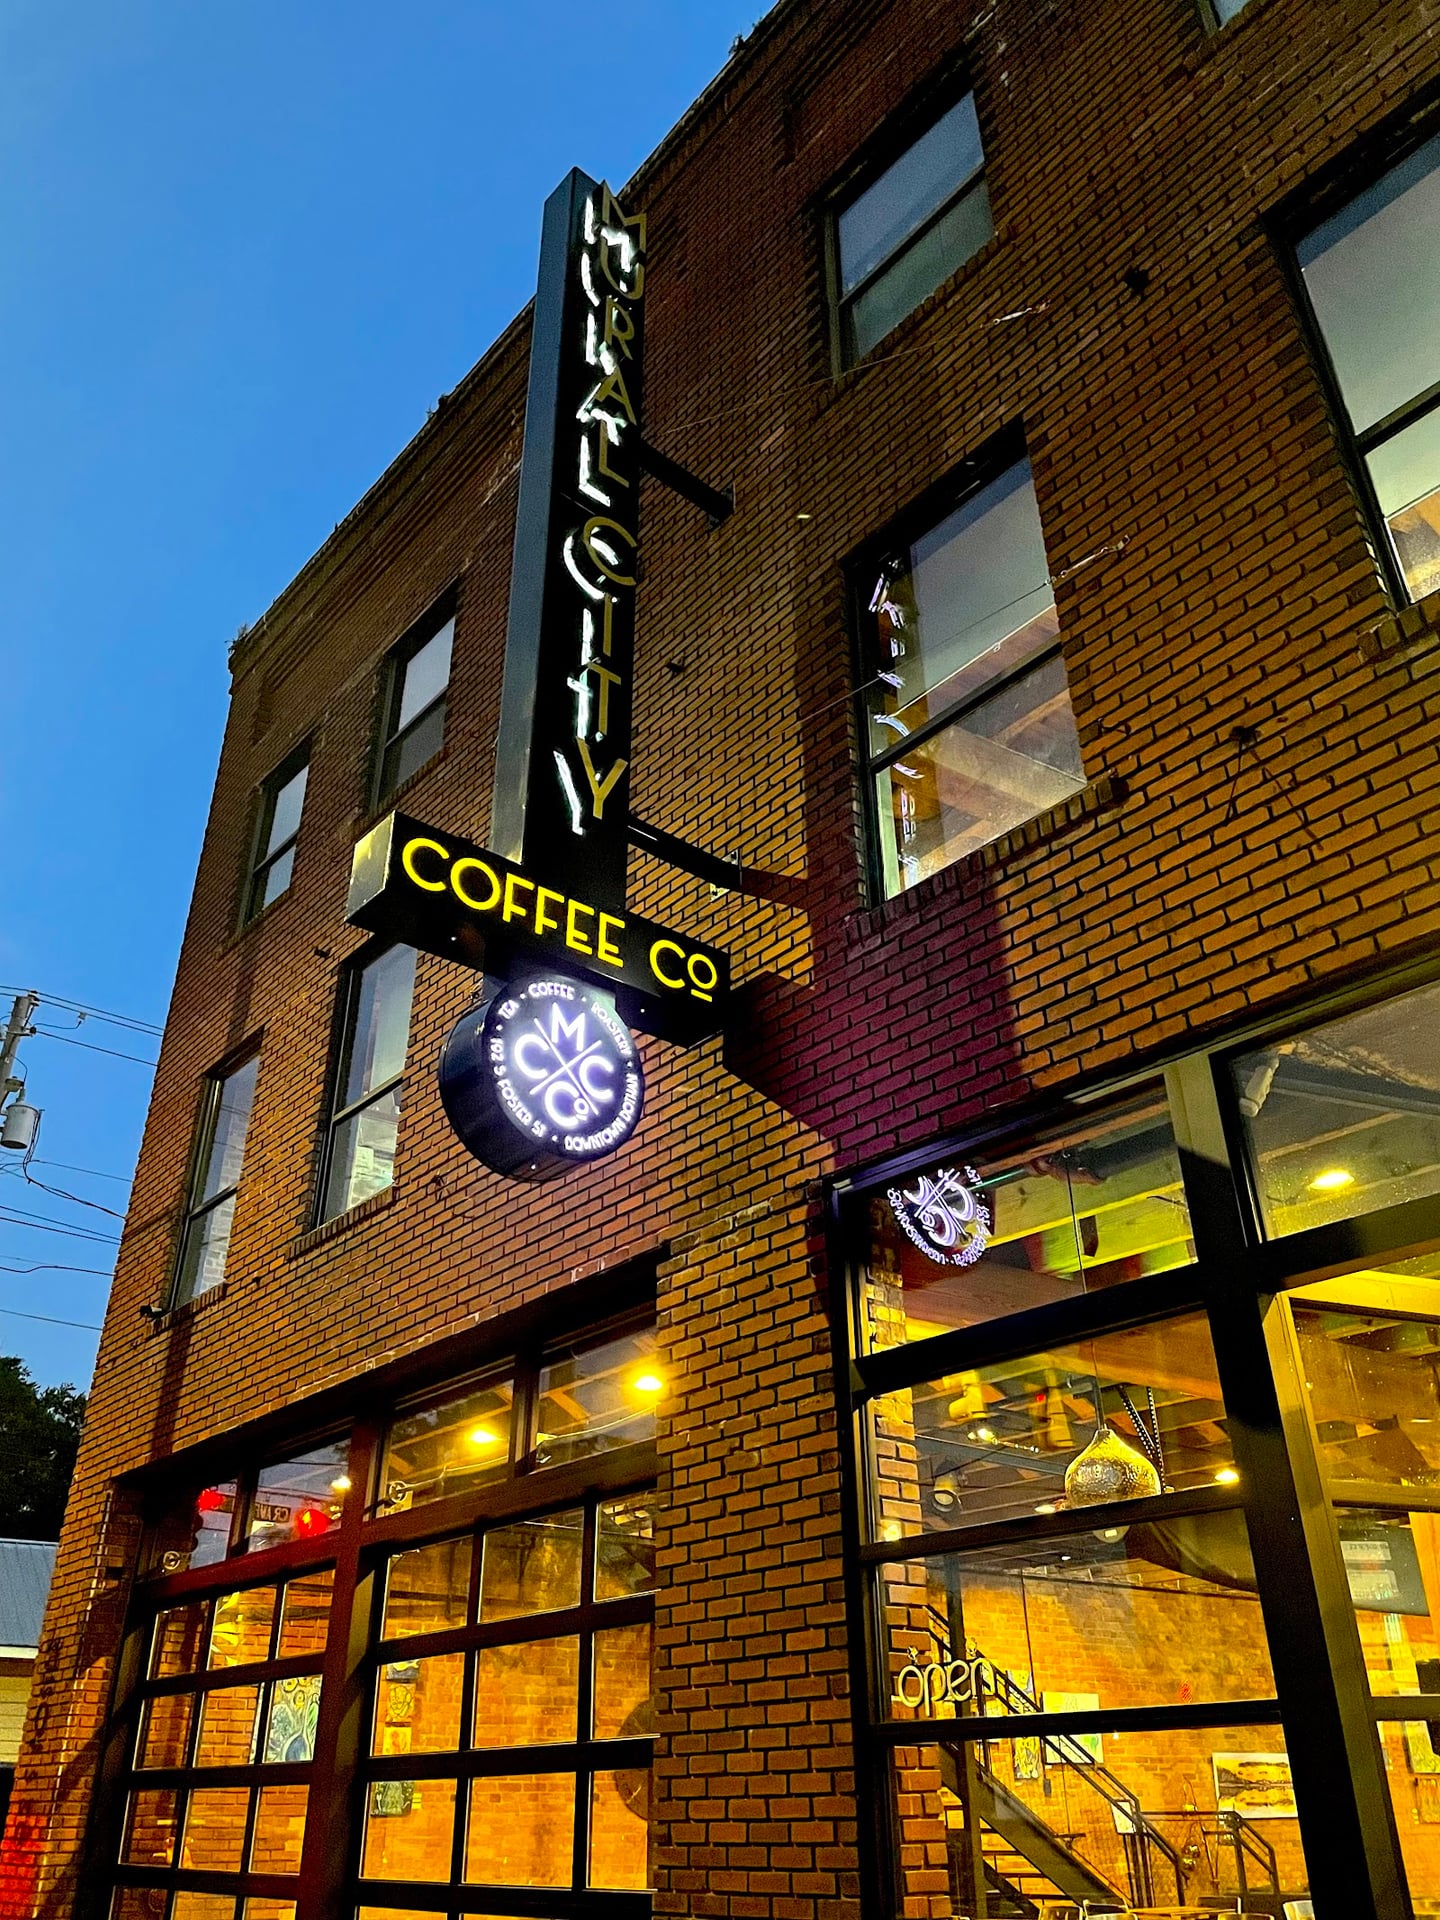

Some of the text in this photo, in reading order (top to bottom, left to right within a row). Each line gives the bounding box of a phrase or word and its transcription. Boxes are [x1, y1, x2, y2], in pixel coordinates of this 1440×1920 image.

[553, 178, 647, 836] MURAL CITY
[402, 837, 626, 968] COFFEE
[498, 982, 632, 1056] TEA COFFEE ROASTERY
[490, 1037, 504, 1061] 201
[497, 1078, 532, 1125] FOSTER
[564, 1116, 627, 1151] DOWNTOWN
[898, 1657, 995, 1717] open
